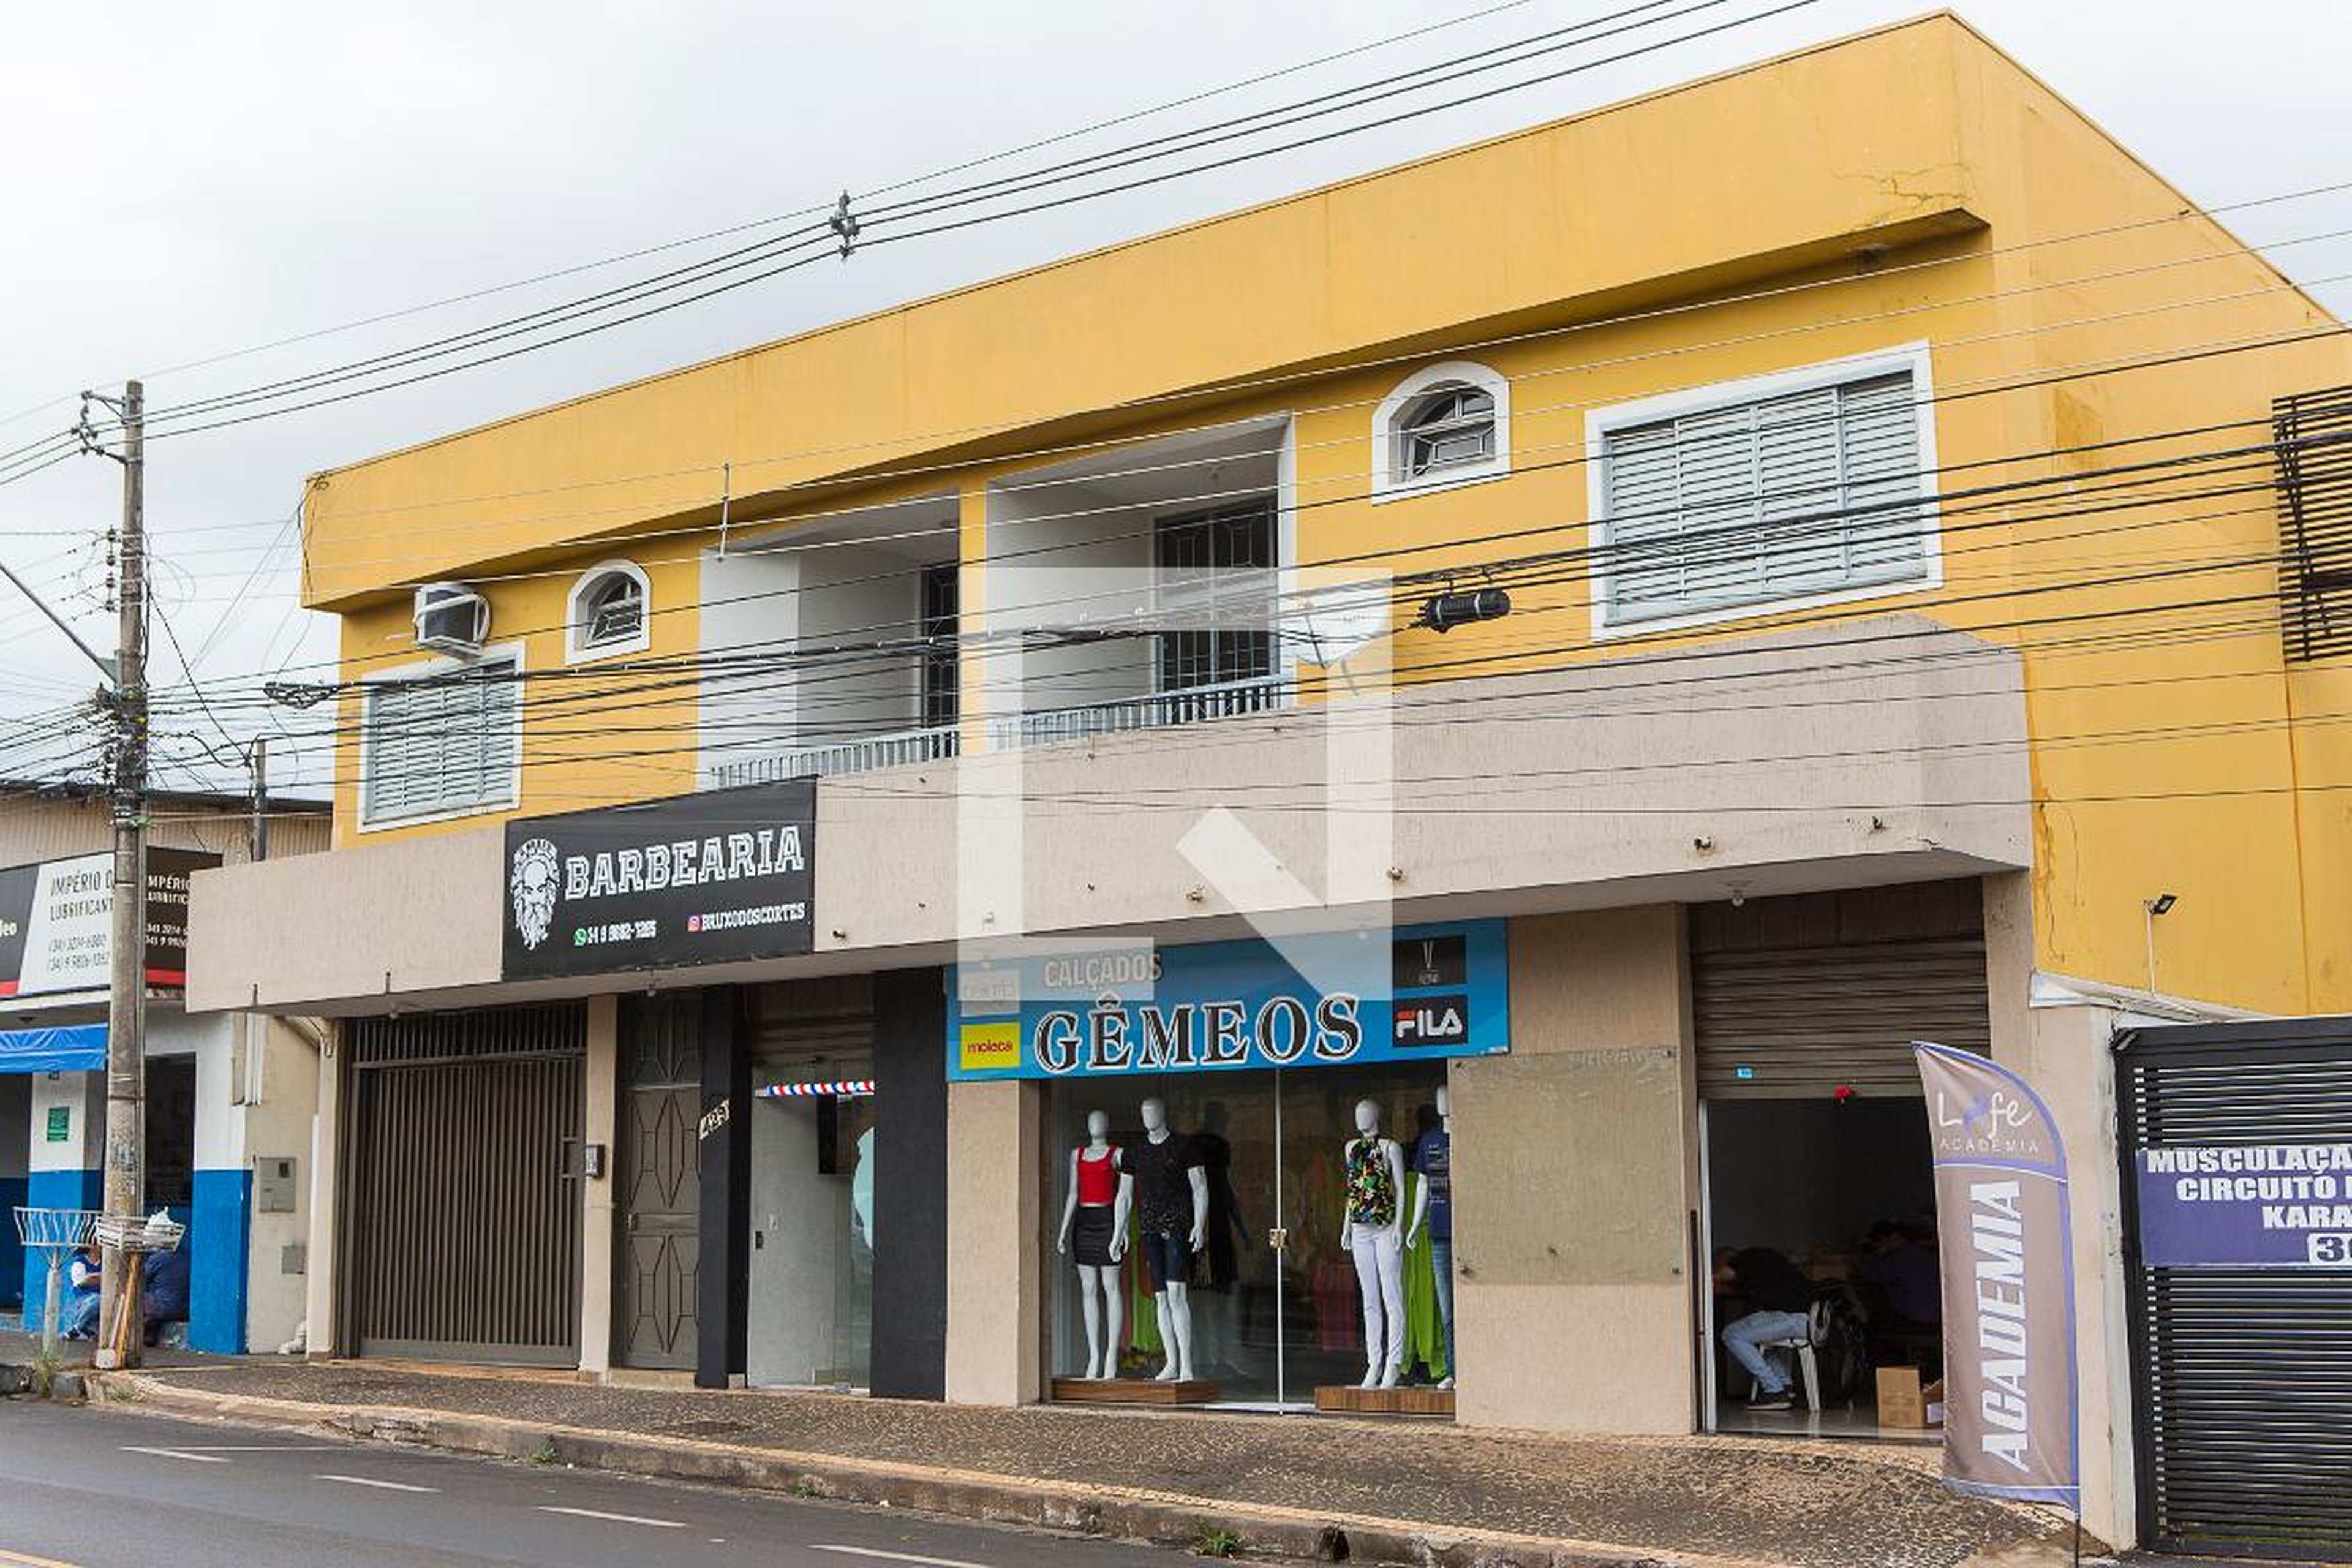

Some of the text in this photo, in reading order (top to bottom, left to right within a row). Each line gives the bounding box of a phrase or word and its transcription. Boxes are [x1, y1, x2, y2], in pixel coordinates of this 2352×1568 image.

[564, 824, 806, 900] BARBEARIA
[50, 870, 101, 897] IMPÉRIO
[1044, 952, 1163, 993] CALÇADOS
[1033, 991, 1362, 1074] GÊMEOS
[1396, 1008, 1463, 1041] FILA
[967, 1039, 1013, 1054] moleca
[1939, 1138, 2039, 1153] ACADEMIA
[2176, 1175, 2336, 1202] CIRCUITO
[2316, 1237, 2352, 1262] 3
[1970, 1180, 2029, 1473] ACADEMIA
